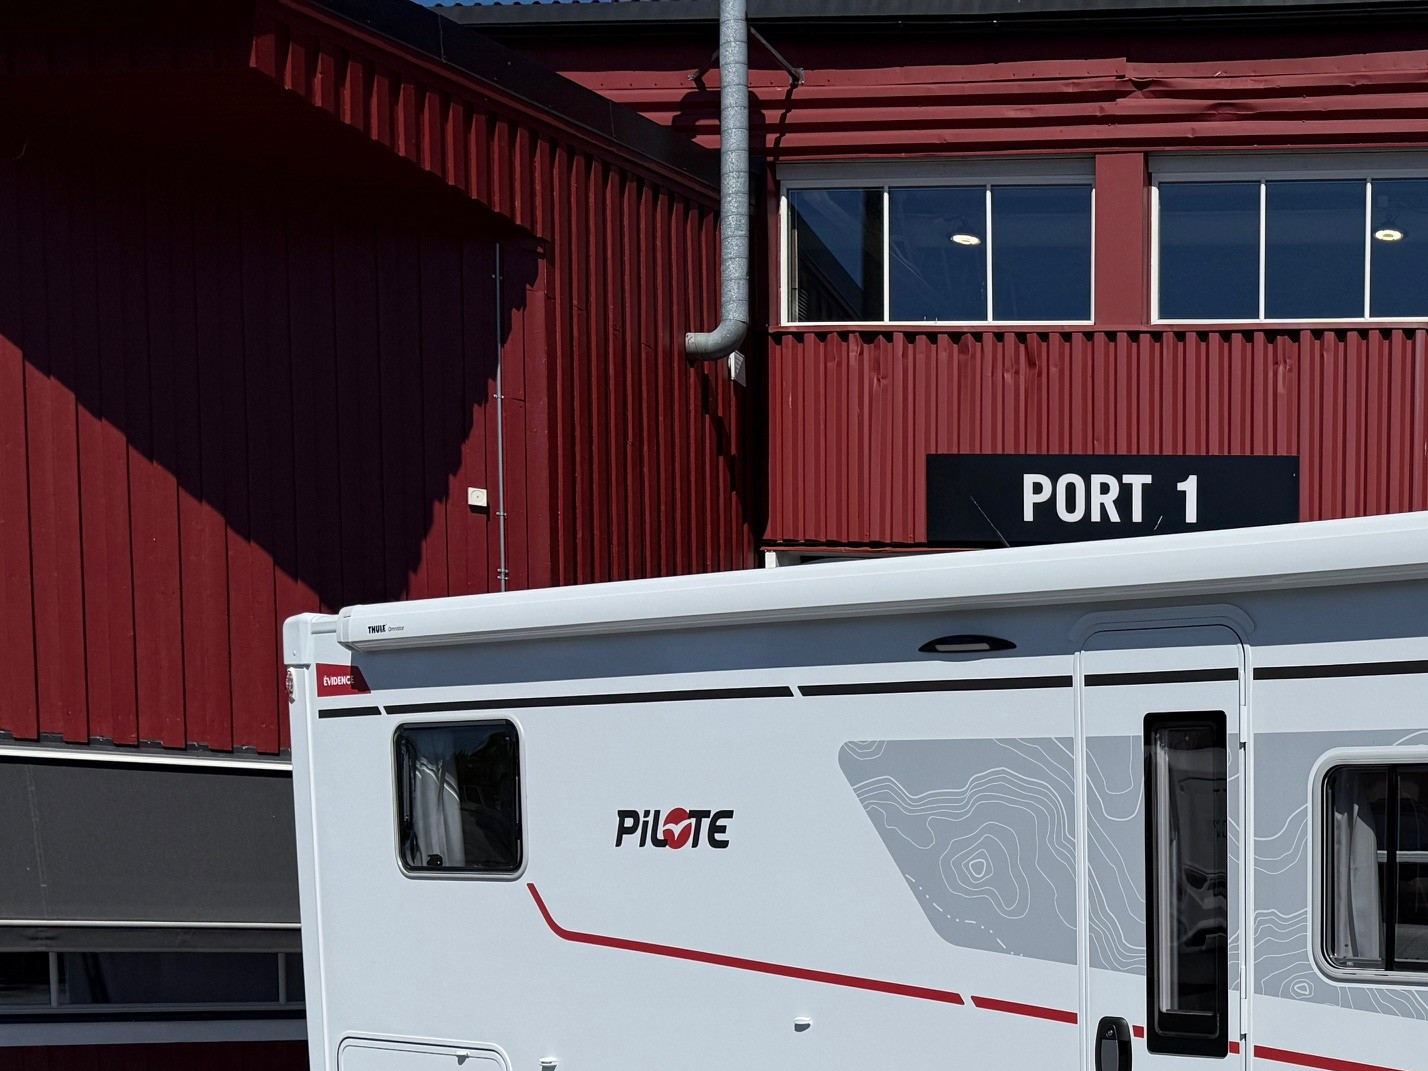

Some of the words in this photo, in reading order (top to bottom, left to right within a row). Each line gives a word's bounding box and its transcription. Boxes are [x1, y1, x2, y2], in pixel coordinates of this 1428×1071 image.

[1023, 473, 1152, 523] PORT
[1176, 474, 1198, 524] 1
[367, 624, 387, 634] THULE
[323, 675, 355, 687] ÉVIDENCE
